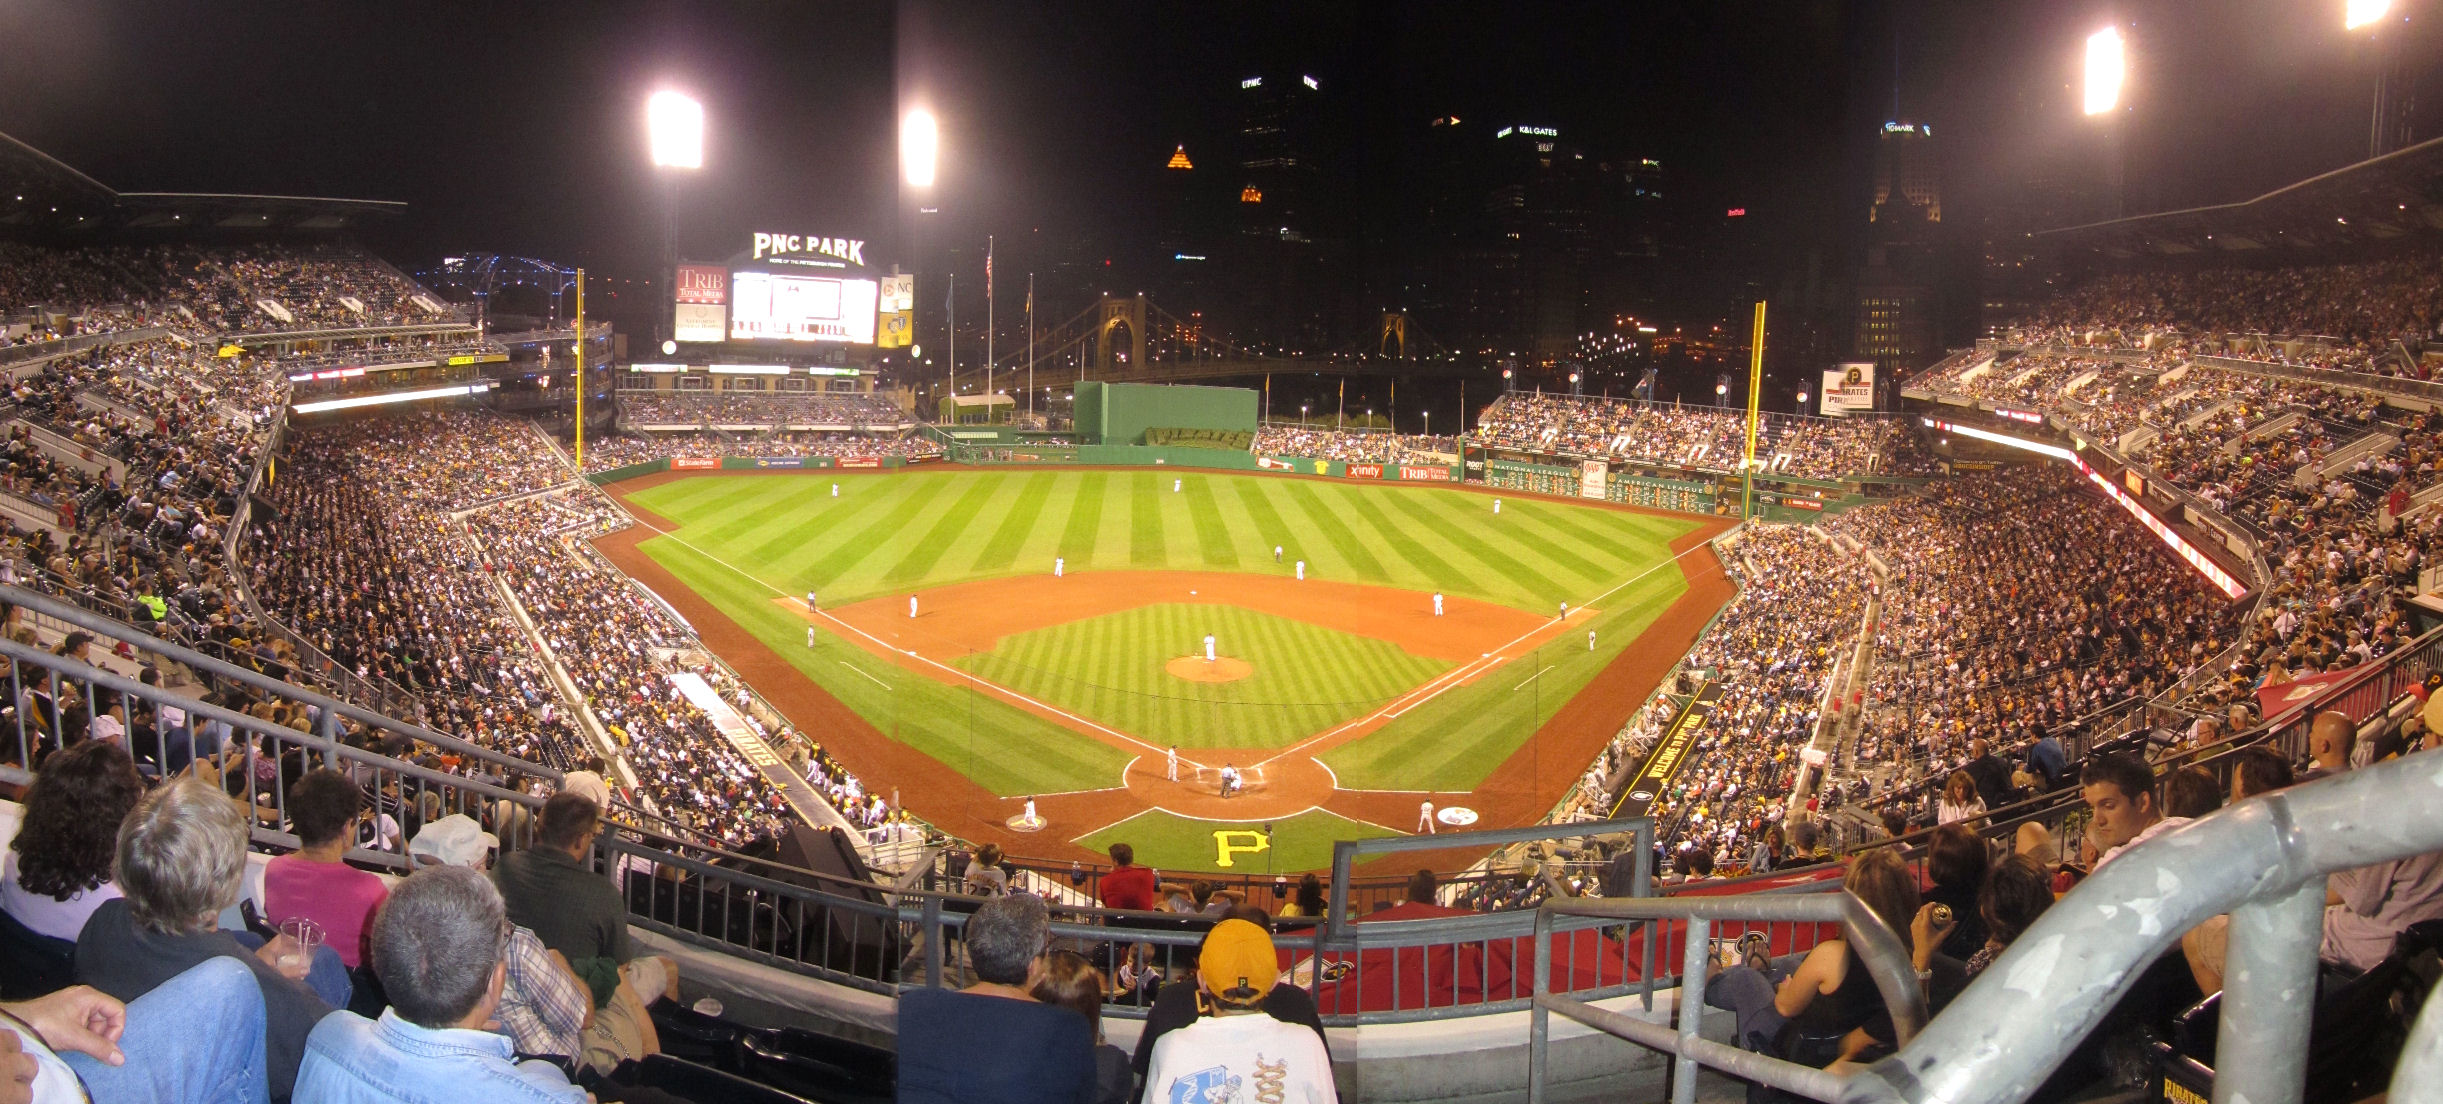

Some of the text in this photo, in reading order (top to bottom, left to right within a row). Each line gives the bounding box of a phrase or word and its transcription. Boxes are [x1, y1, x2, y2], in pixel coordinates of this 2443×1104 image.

[1242, 77, 1262, 89] UPMC
[1519, 125, 1533, 134] K&L
[1534, 127, 1557, 136] GATES
[753, 232, 865, 267] PNC PARK
[680, 269, 724, 289] TRIB
[680, 288, 724, 298] TOTAL MEDIA
[1351, 464, 1380, 478] xfinity
[1466, 460, 1484, 468] ROOT
[1494, 464, 1570, 477] NATIONAL LEAGUE
[1400, 466, 1428, 480] TRIB
[1617, 479, 1704, 494] AMERICAN LEAGUE
[733, 727, 779, 766] PIRATES
[1647, 746, 1682, 778] WELCOME
[1681, 713, 1704, 729] PARK
[1212, 830, 1271, 867] P
[1239, 978, 1247, 988] P
